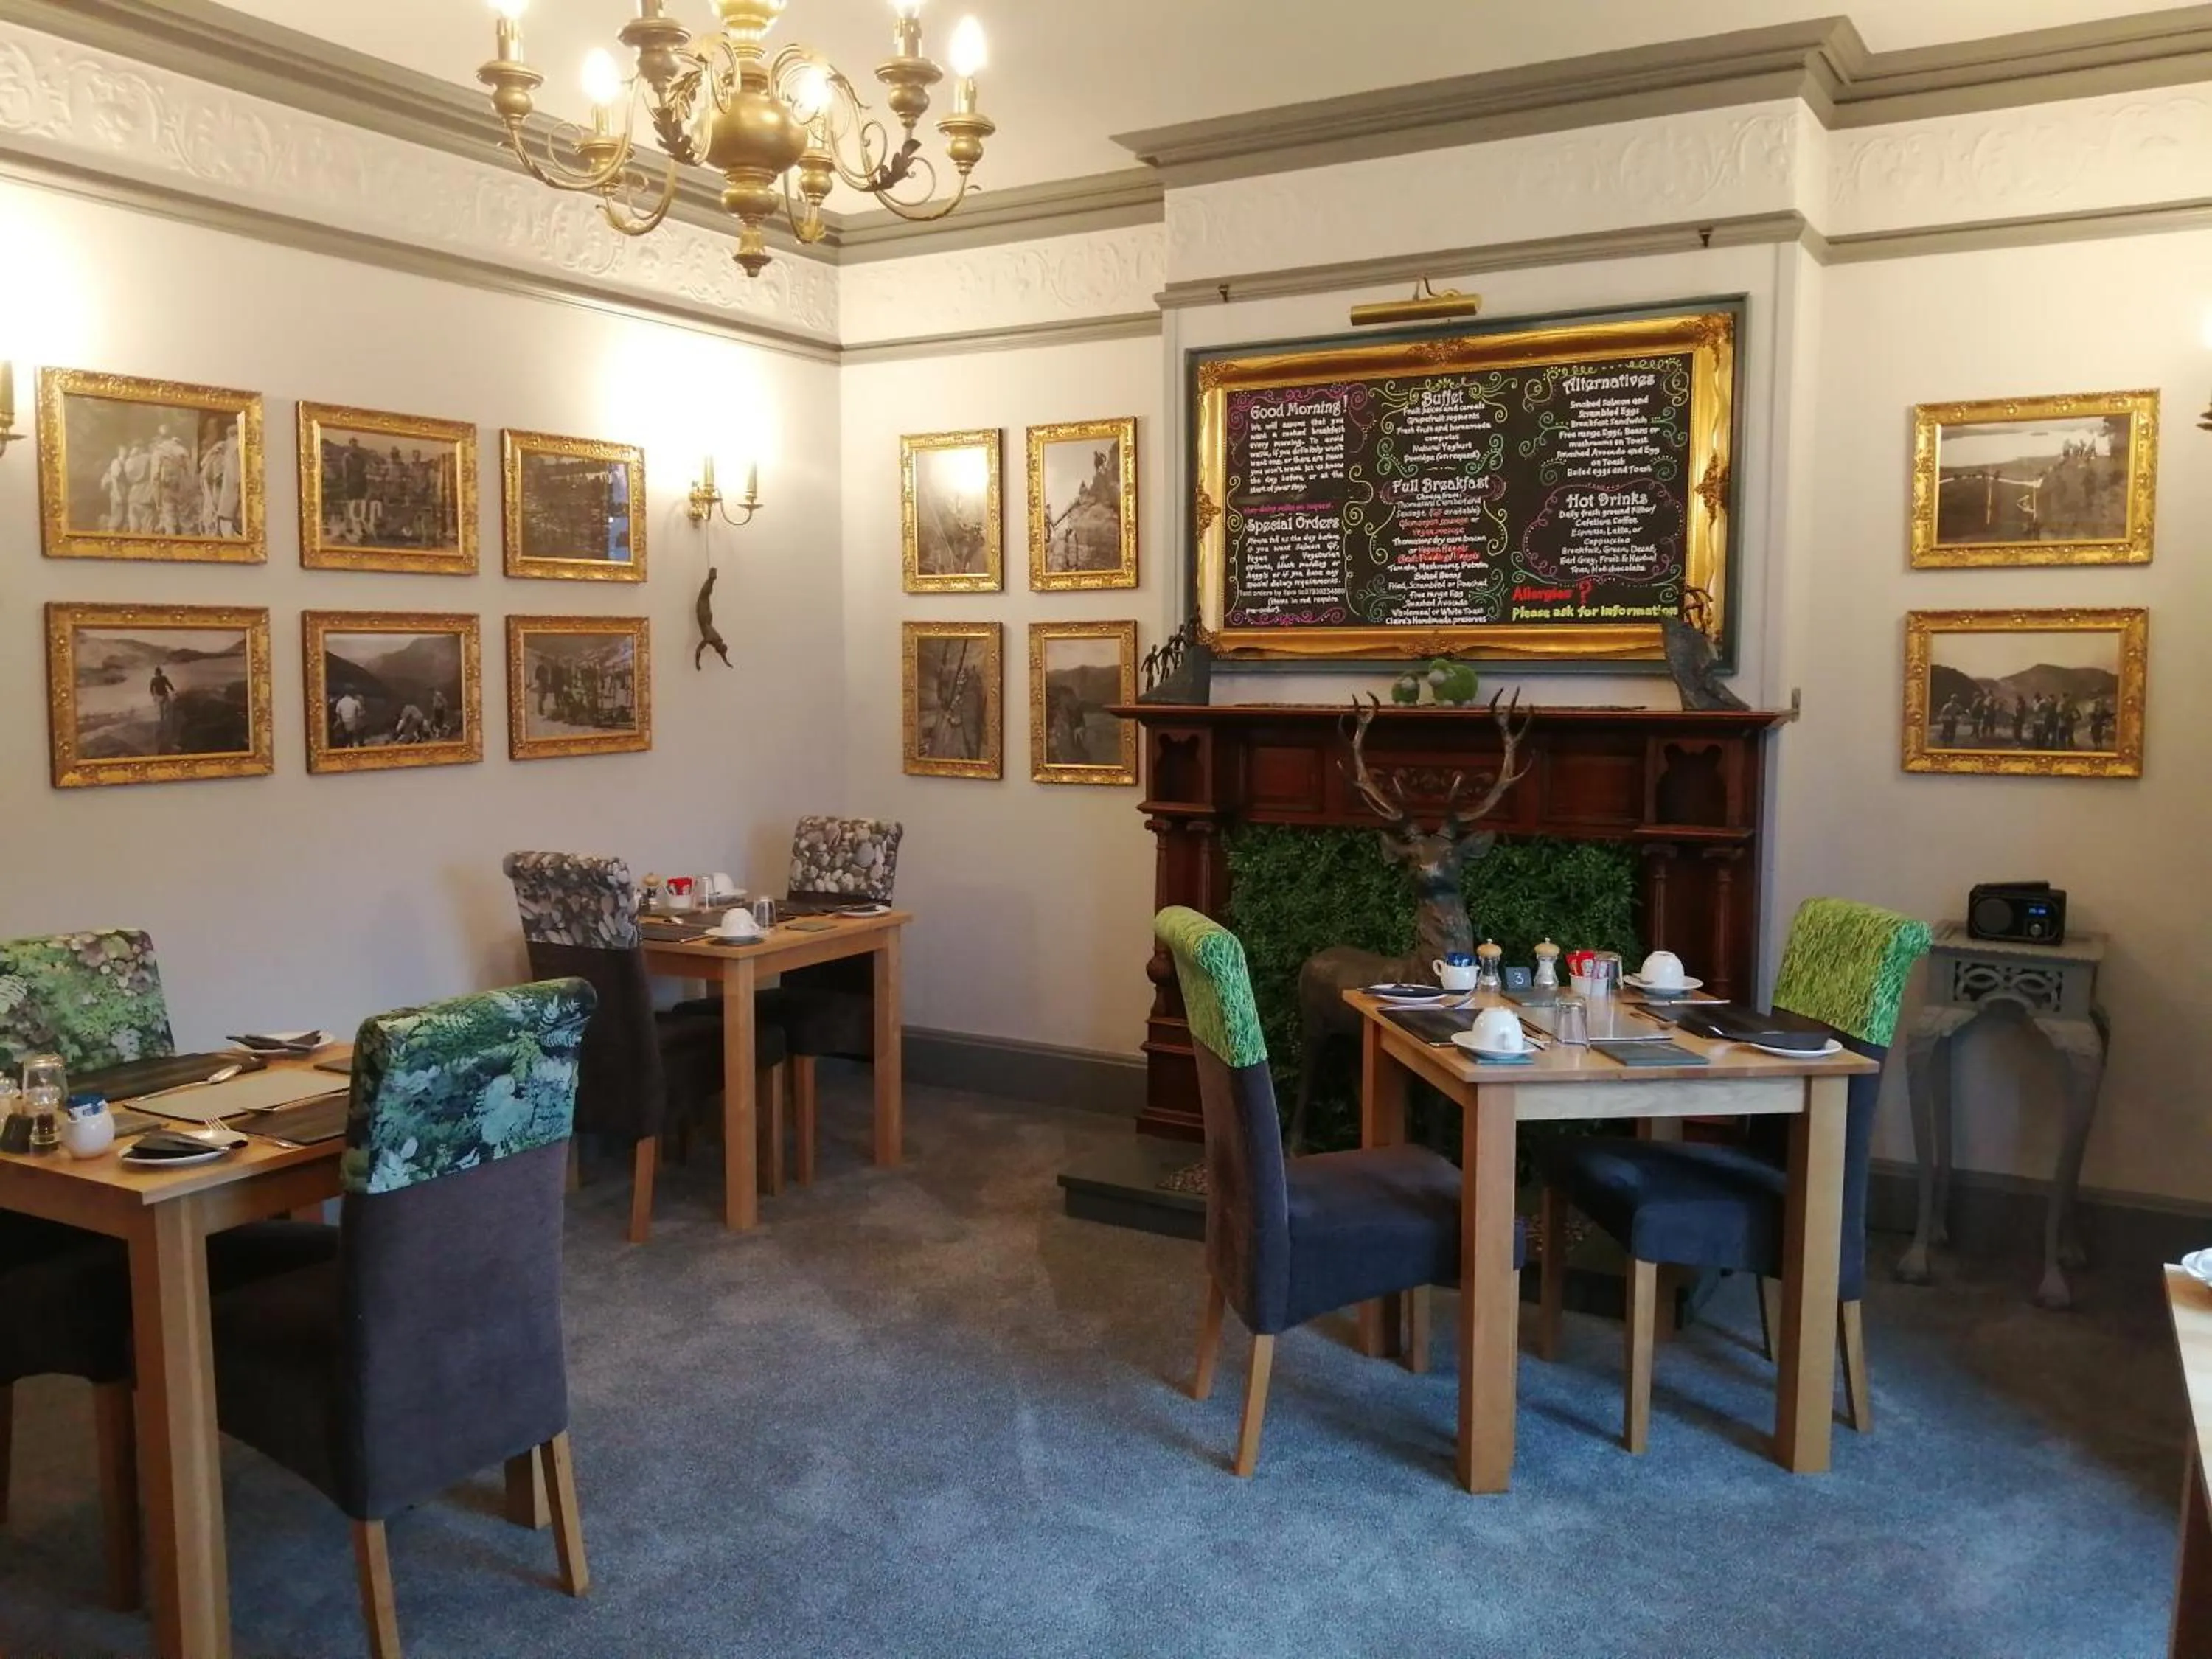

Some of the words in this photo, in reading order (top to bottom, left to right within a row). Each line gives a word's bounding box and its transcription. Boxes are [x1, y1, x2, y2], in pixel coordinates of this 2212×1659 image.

[1563, 374, 1655, 394] Alternatives
[1421, 389, 1464, 407] Buffet
[1251, 403, 1284, 420] Good
[1391, 478, 1419, 494] Full
[1422, 474, 1489, 493] Breakfast
[1566, 493, 1594, 509] Hot
[1598, 490, 1648, 507] Drinks
[1245, 518, 1293, 535] Special
[1295, 515, 1340, 530] Orders
[1512, 587, 1573, 602] Allergies
[1512, 606, 1551, 622] Please
[1553, 605, 1574, 617] ask
[1578, 605, 1599, 617] for
[1601, 604, 1678, 616] information
[1514, 973, 1524, 984] 3
